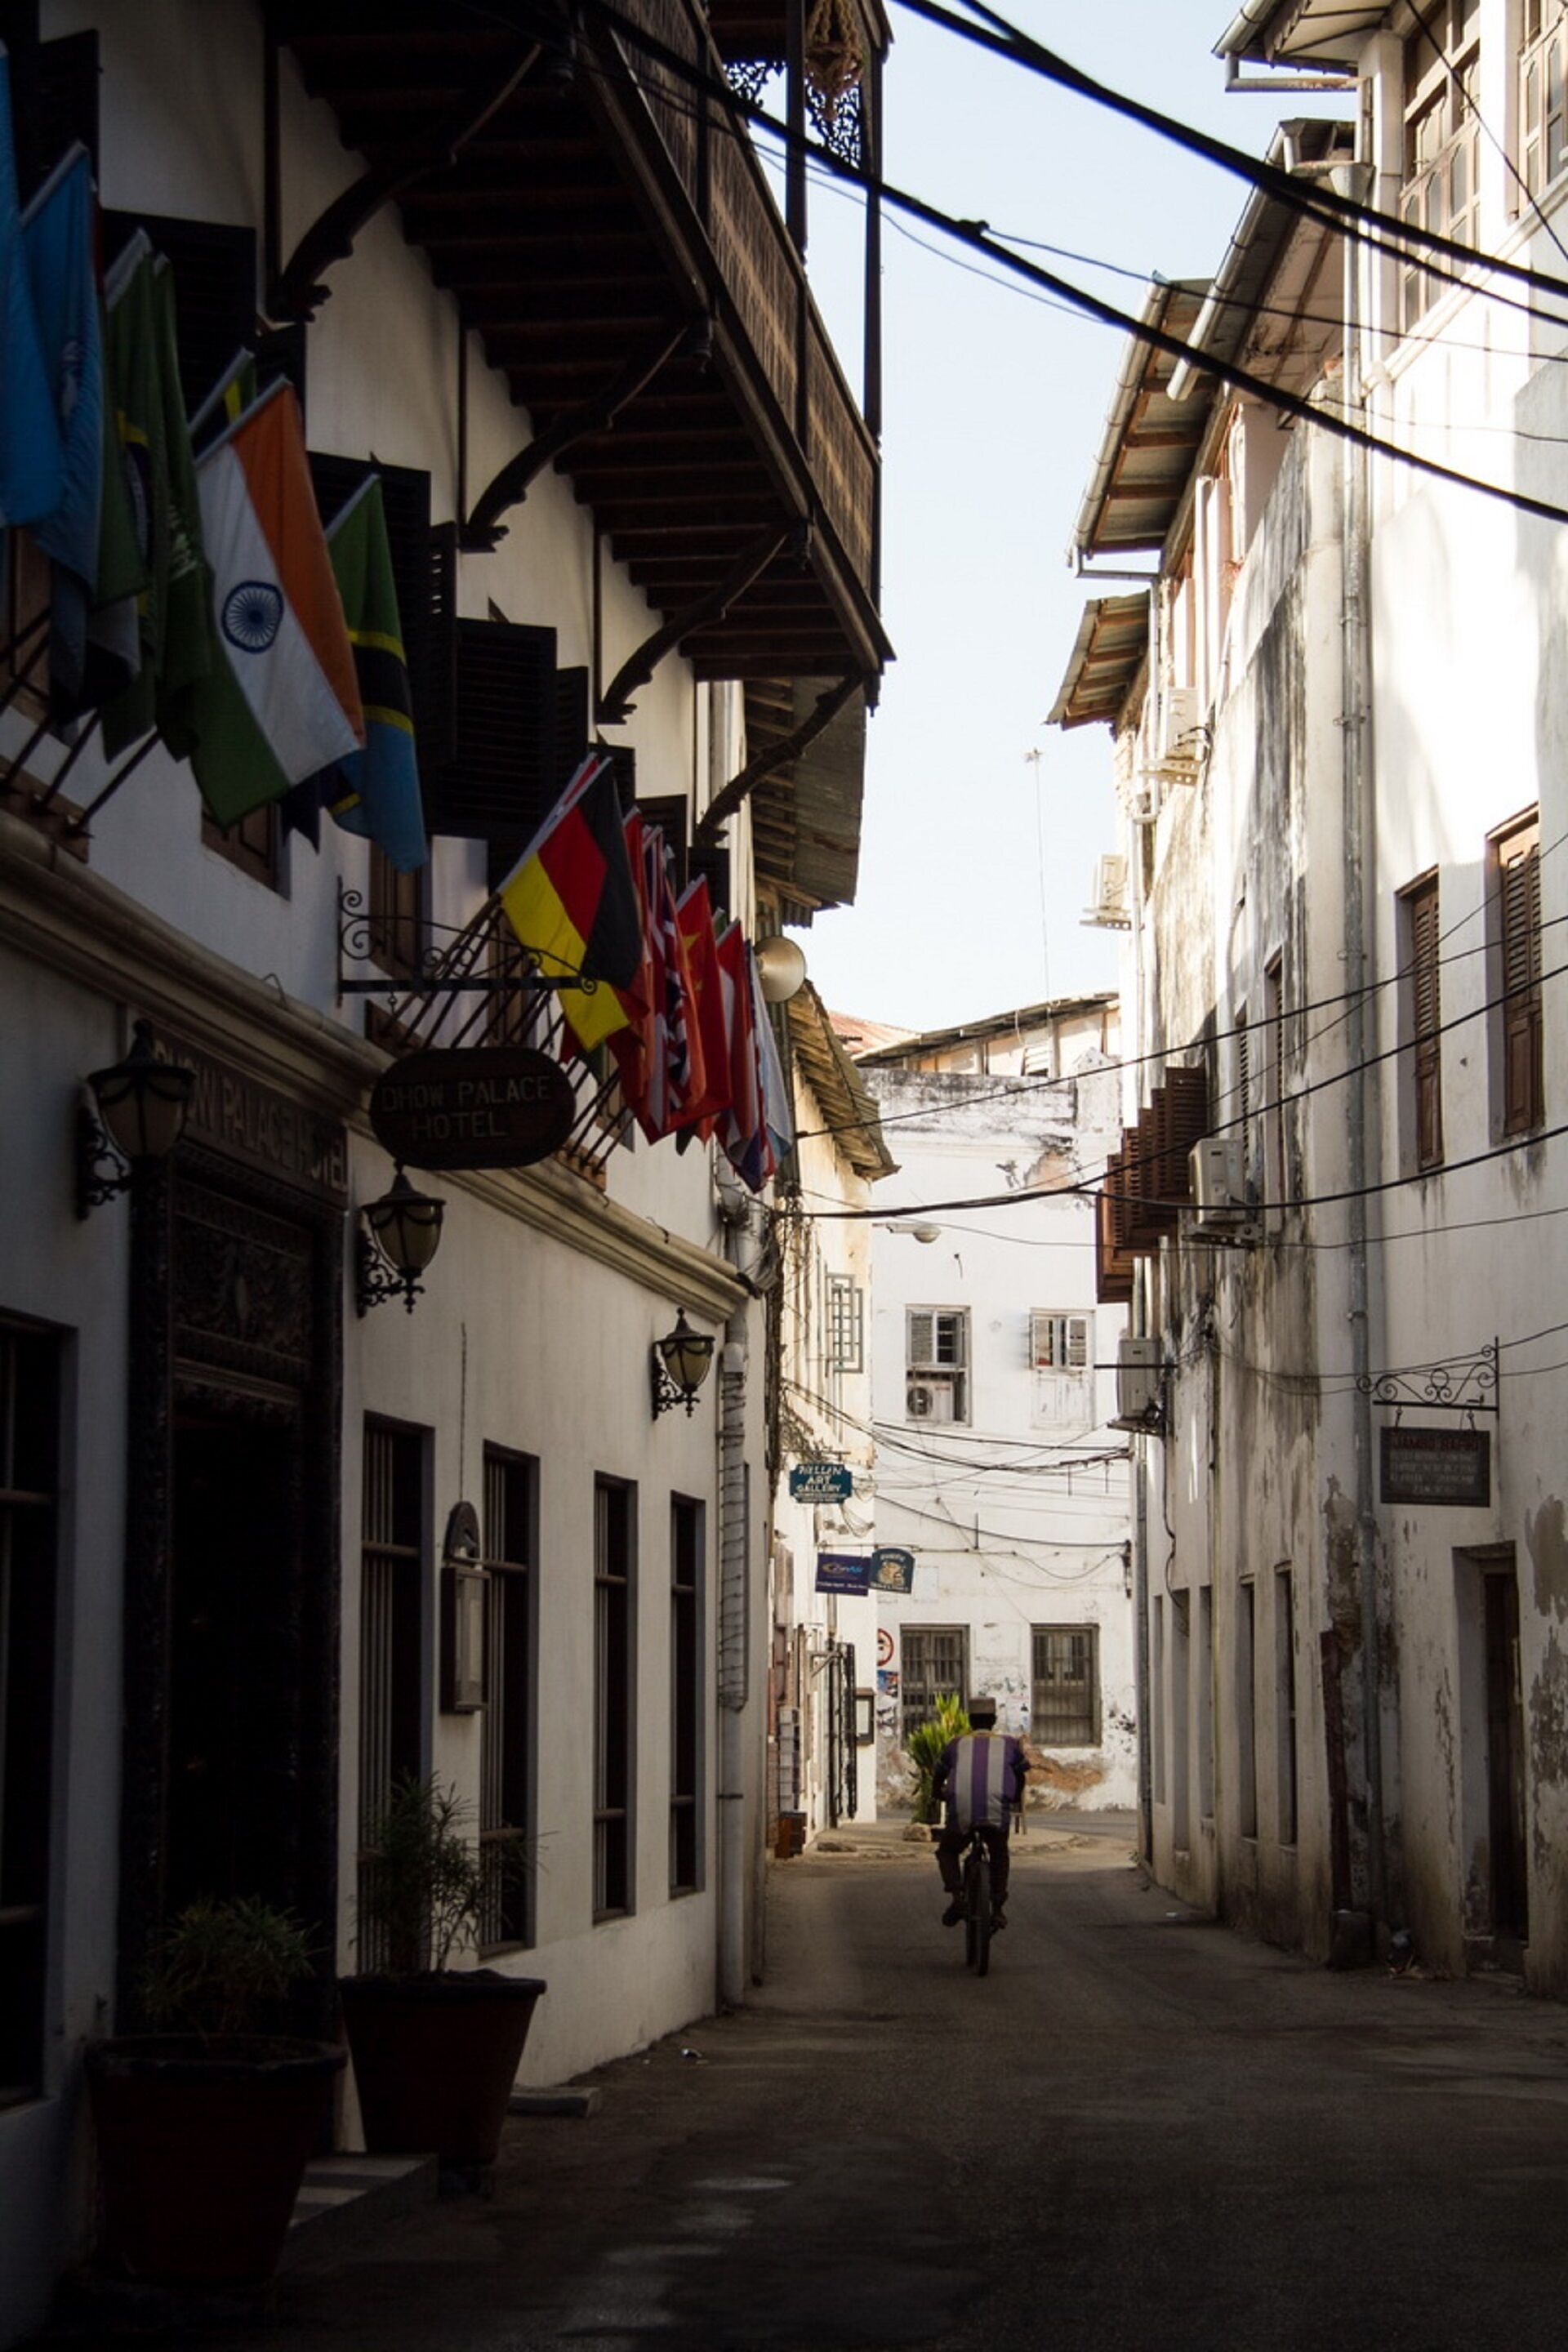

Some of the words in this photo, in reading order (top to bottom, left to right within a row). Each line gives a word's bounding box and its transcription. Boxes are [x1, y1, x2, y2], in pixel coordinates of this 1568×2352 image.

[381, 1084, 444, 1111] DHOW
[458, 1076, 550, 1106] PALACE
[412, 1111, 510, 1140] HOTEL
[807, 1475, 831, 1484] ART
